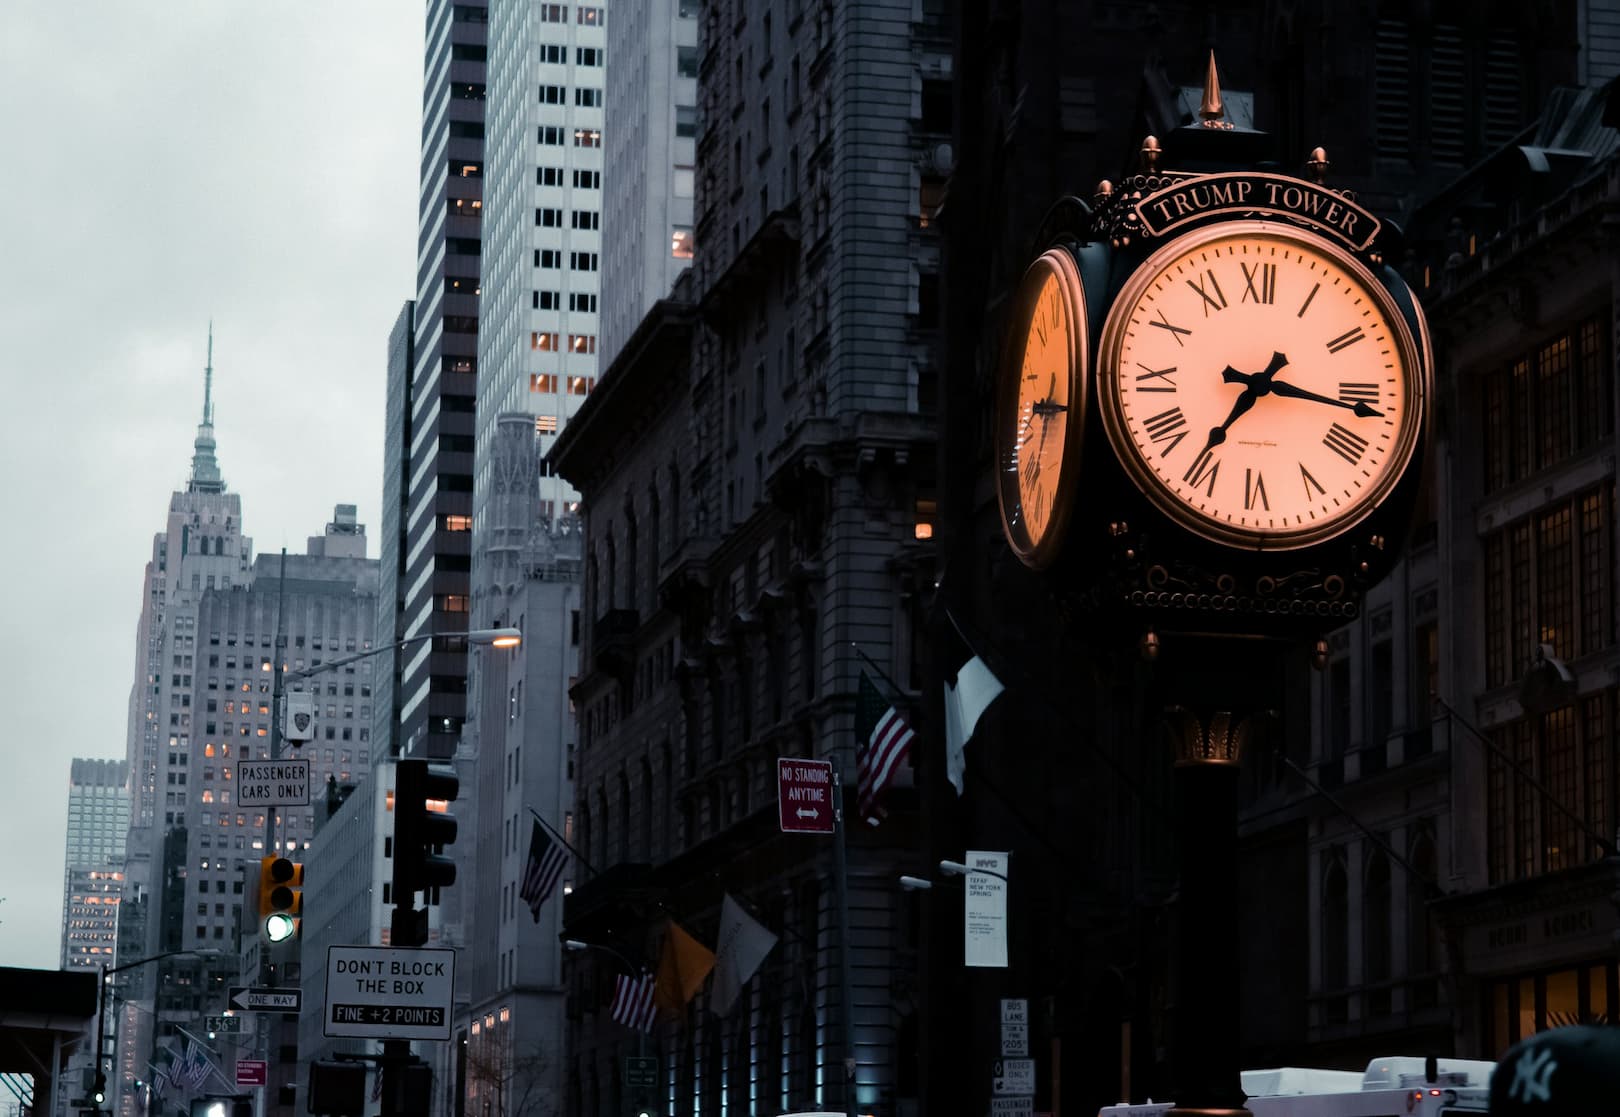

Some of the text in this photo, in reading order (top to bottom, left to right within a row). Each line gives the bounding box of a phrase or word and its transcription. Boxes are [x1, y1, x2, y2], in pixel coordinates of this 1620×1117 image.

[1152, 181, 1358, 236] TRUMP TOWER
[1241, 262, 1276, 305] XII
[1186, 269, 1228, 318] XI
[1149, 309, 1192, 347] X
[1136, 362, 1177, 392] IX
[1143, 406, 1190, 458] VIII
[1244, 468, 1270, 511] VI
[242, 766, 305, 780] PASSENGER
[781, 767, 829, 784] NO STANDING
[242, 784, 305, 798] CARS ONLY
[788, 786, 825, 802] ANYTIME
[976, 859, 998, 868] NYC
[336, 960, 444, 976] DON'T BLOCK
[356, 979, 424, 994] THE BOX
[248, 994, 295, 1005] ONE WAY
[1007, 1002, 1021, 1010] BUS
[336, 1006, 365, 1022] FINE
[395, 1009, 440, 1024] POINTS
[1004, 1012, 1024, 1021] LANE
